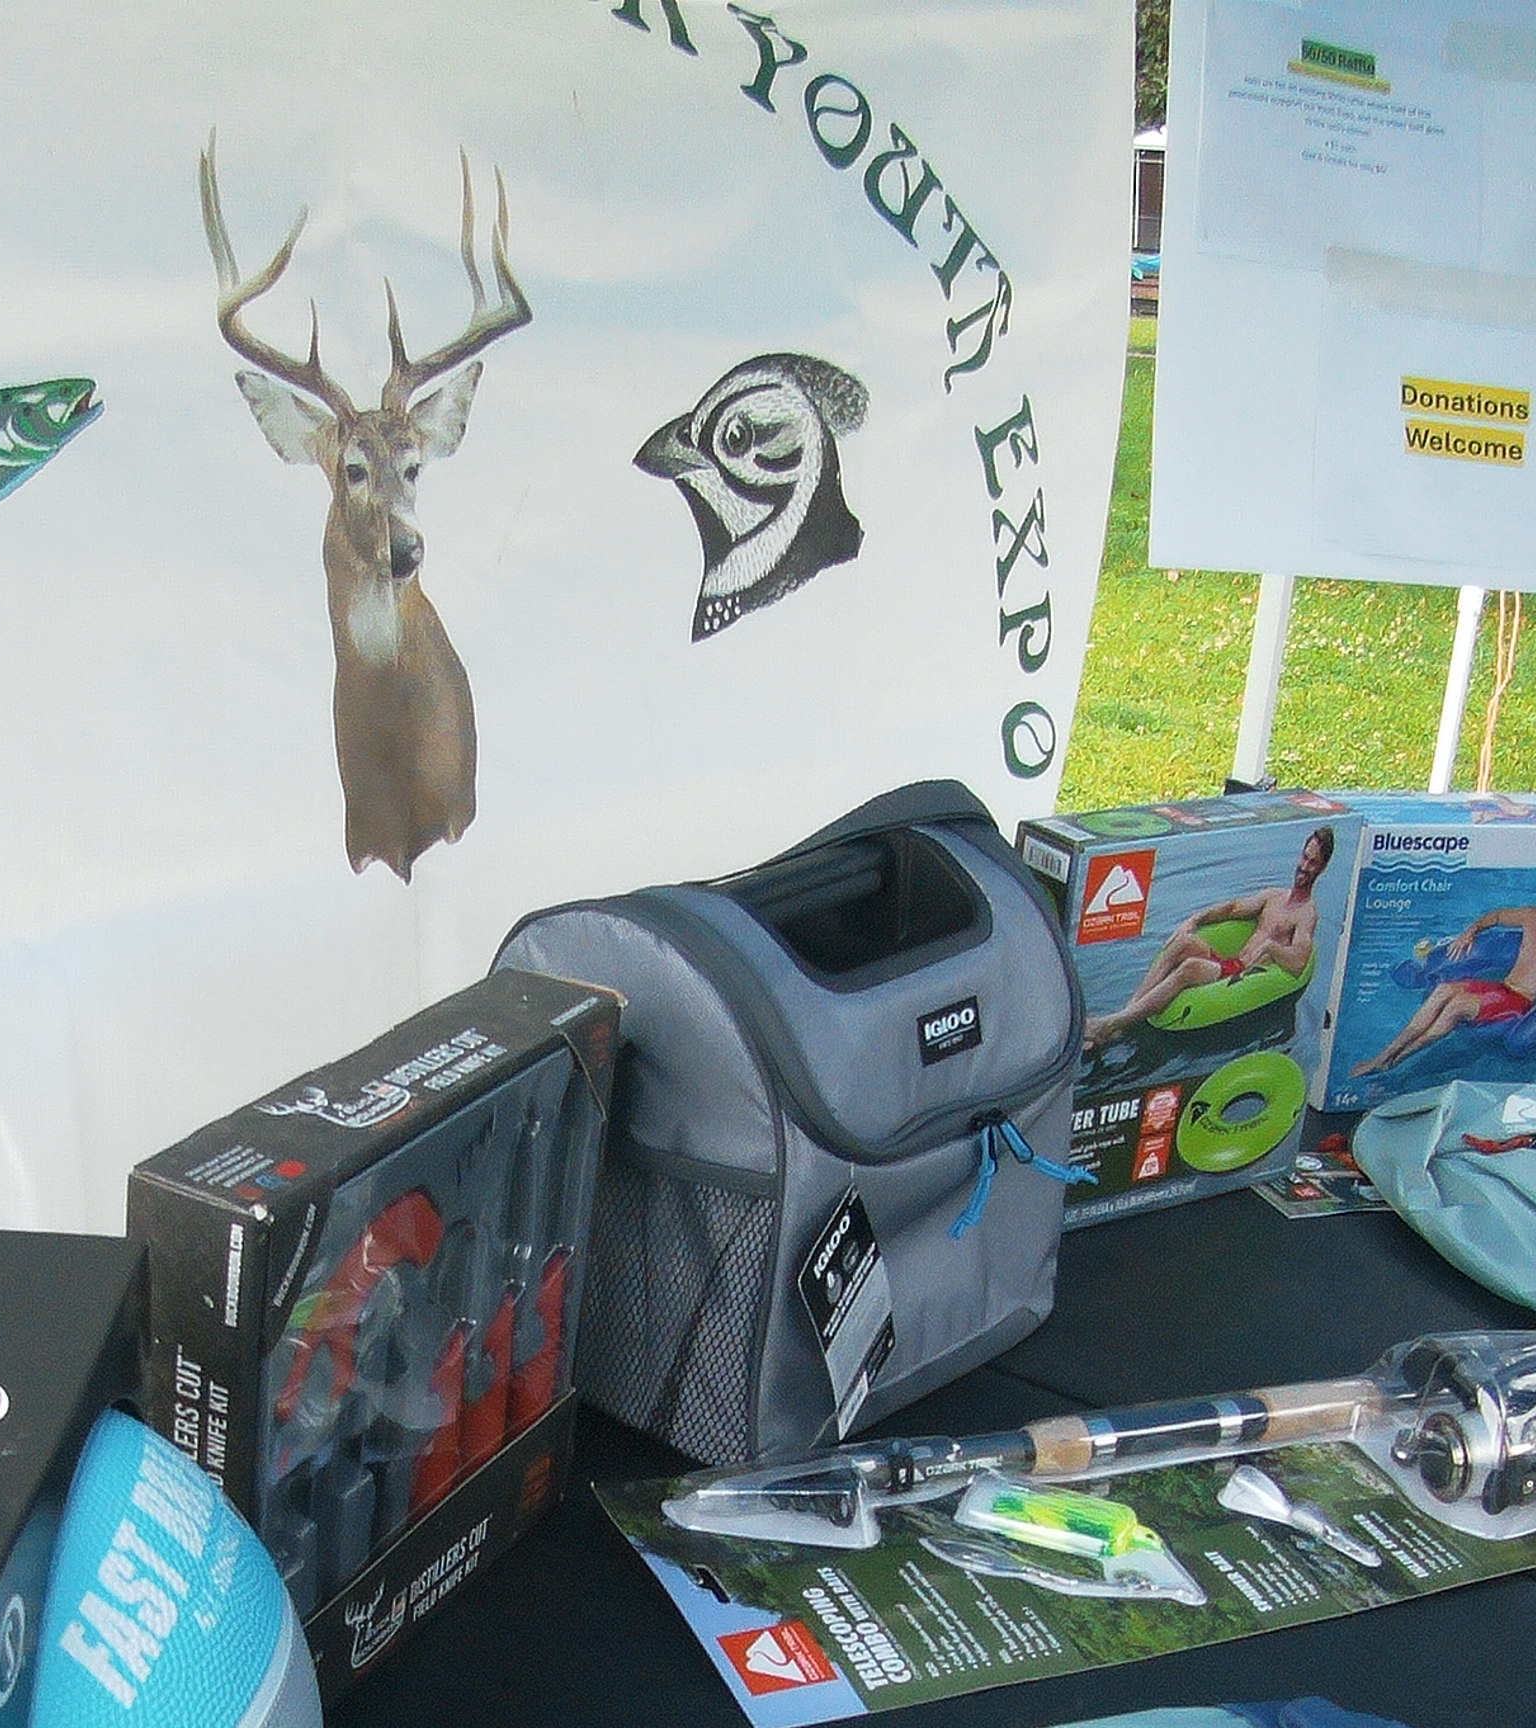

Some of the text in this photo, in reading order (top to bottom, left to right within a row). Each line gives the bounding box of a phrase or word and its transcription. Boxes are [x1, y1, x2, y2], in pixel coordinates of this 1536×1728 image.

[725, 1, 1014, 395] YOUTH
[974, 392, 1056, 780] EXPO
[1401, 383, 1529, 420] Donations
[1405, 426, 1523, 461] Welcome
[1372, 833, 1470, 855] Bluescape
[1367, 876, 1452, 894] Comfort Chair
[1365, 896, 1413, 913] Lounge
[924, 1008, 975, 1041] IGLOO
[1100, 1098, 1141, 1126] TUBE
[209, 1379, 230, 1414] KIT
[207, 1412, 228, 1470] KNIFE
[59, 1516, 190, 1710] FAST
[816, 1565, 913, 1684] COMBO WITH BAITS
[802, 1586, 889, 1691] TELESCOPING
